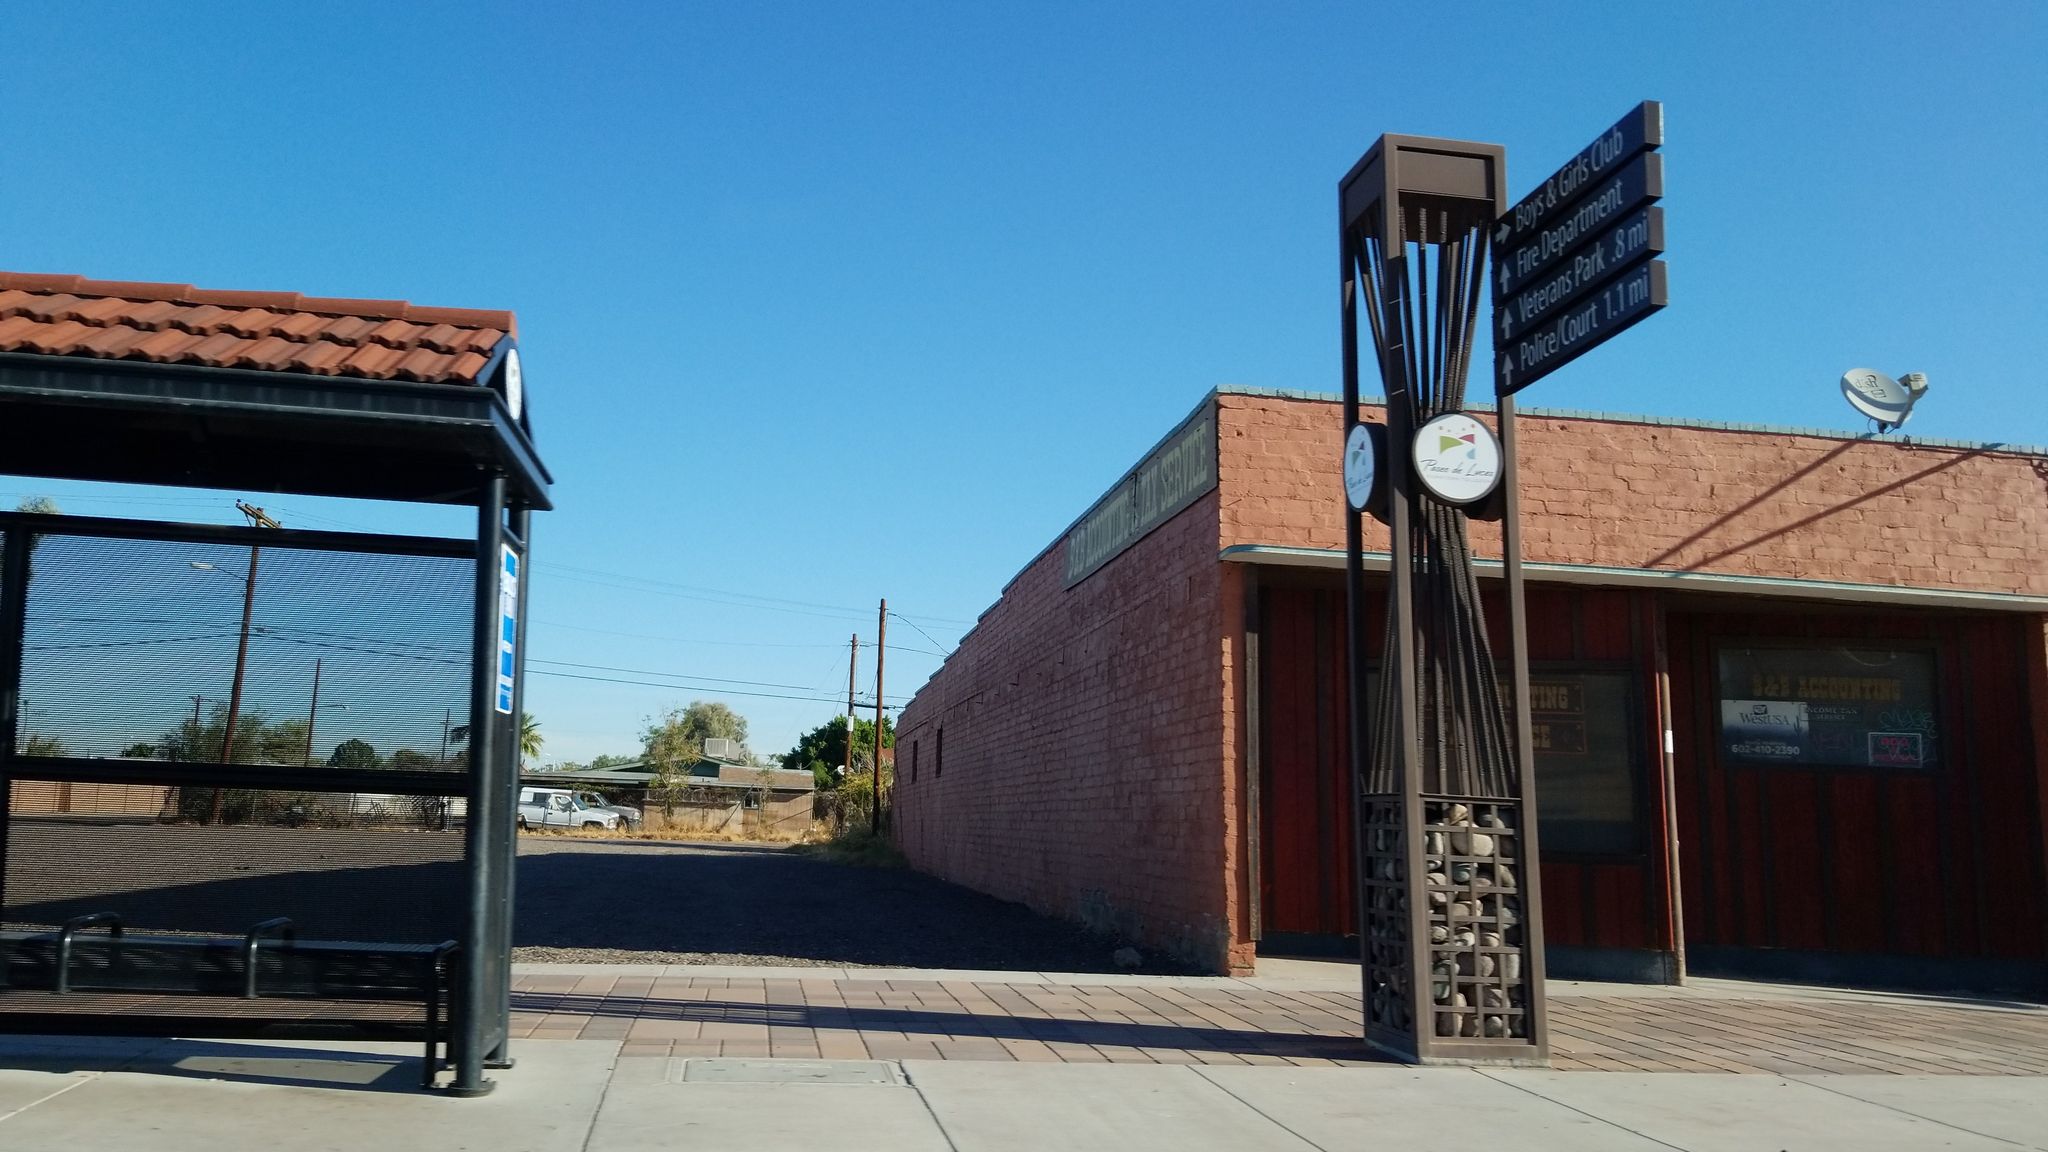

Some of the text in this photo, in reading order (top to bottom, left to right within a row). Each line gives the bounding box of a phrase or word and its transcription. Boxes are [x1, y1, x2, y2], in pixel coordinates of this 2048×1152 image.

[1516, 126, 1623, 232] Boys & Girls Club
[1517, 178, 1622, 278] Fire Department
[1519, 211, 1648, 323] Veterans Park .8 mi
[1520, 267, 1648, 371] Police/Court 1.1 mi
[1161, 422, 1207, 513] SERVICE
[1731, 744, 1800, 756] 602-410-2390
[1804, 706, 1837, 715] NCOME
